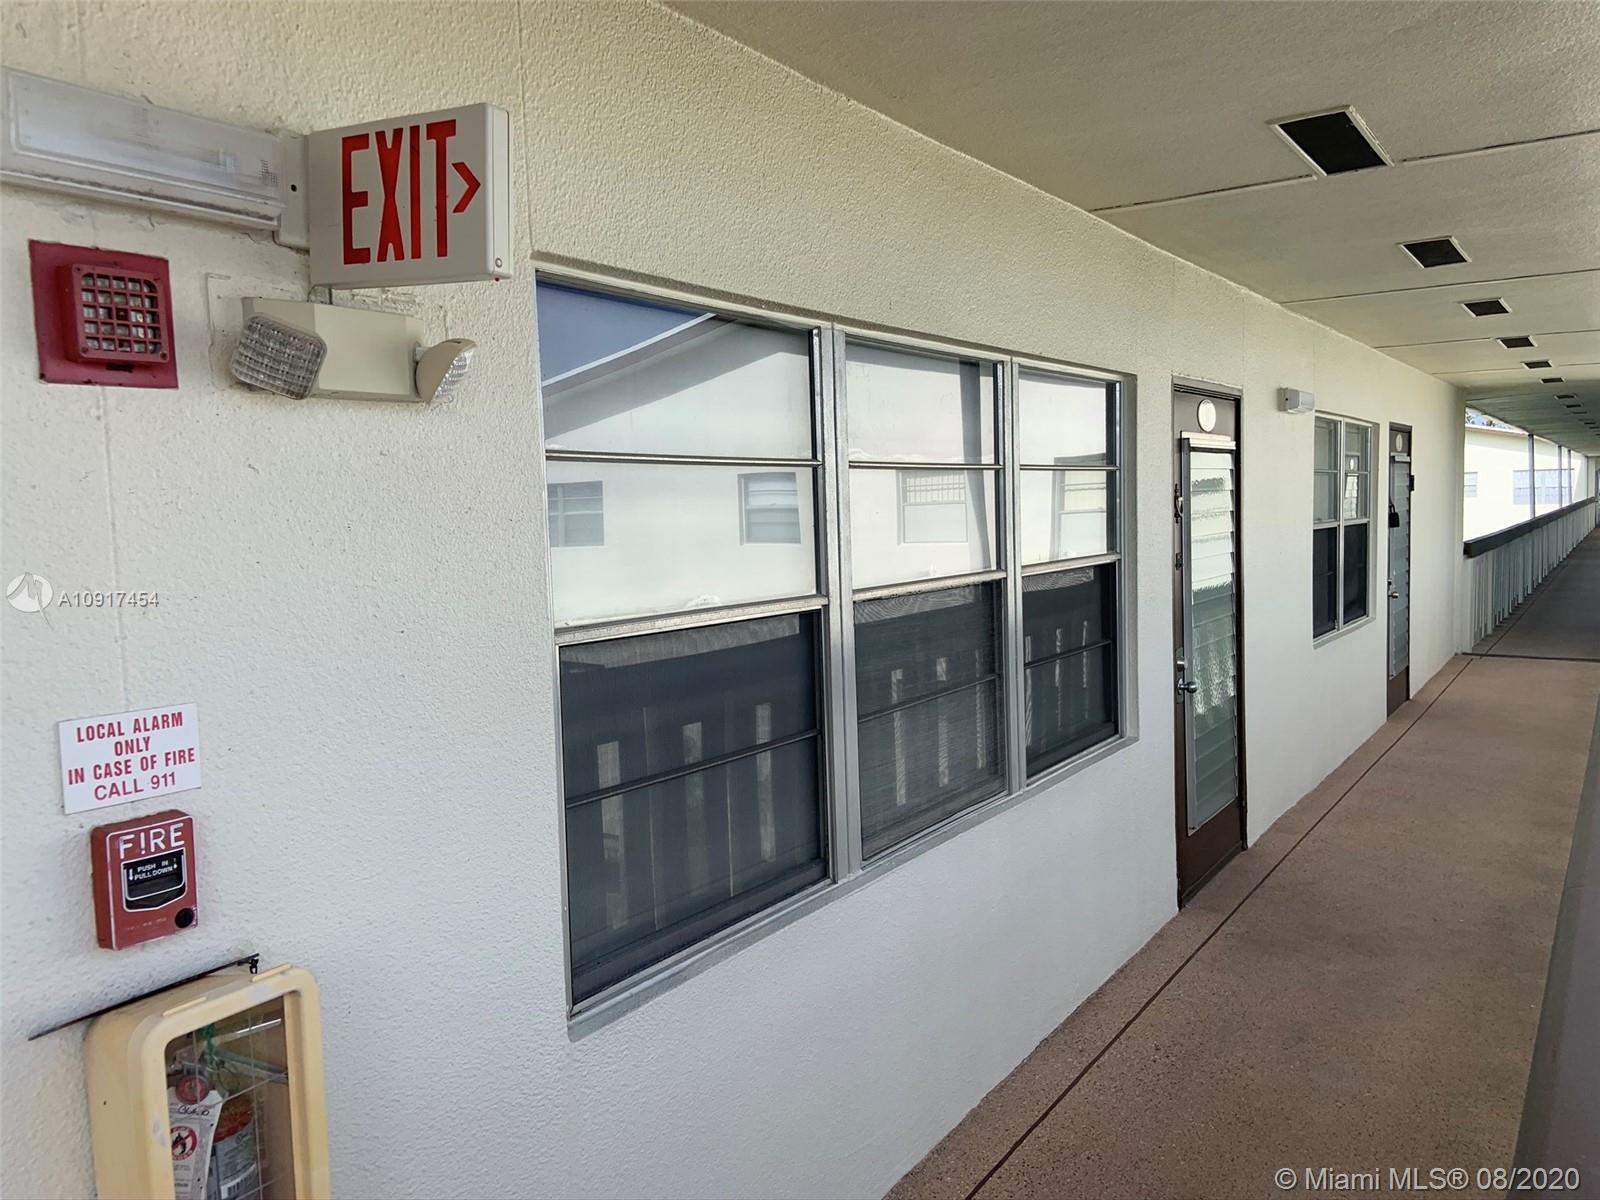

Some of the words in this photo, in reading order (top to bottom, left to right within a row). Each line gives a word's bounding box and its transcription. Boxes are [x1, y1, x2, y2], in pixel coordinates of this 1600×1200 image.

[341, 119, 457, 265] EXIT
[76, 721, 125, 743] LOCAL
[133, 711, 183, 734] ALARM
[114, 736, 151, 756] ONLY
[68, 767, 85, 785] IN
[93, 759, 132, 780] CASE
[140, 754, 157, 771] OF
[164, 747, 195, 767] FIRE
[94, 778, 144, 800] CALL
[151, 772, 176, 790] 911
[119, 822, 185, 859] FIRE
[137, 863, 156, 872] PUSH
